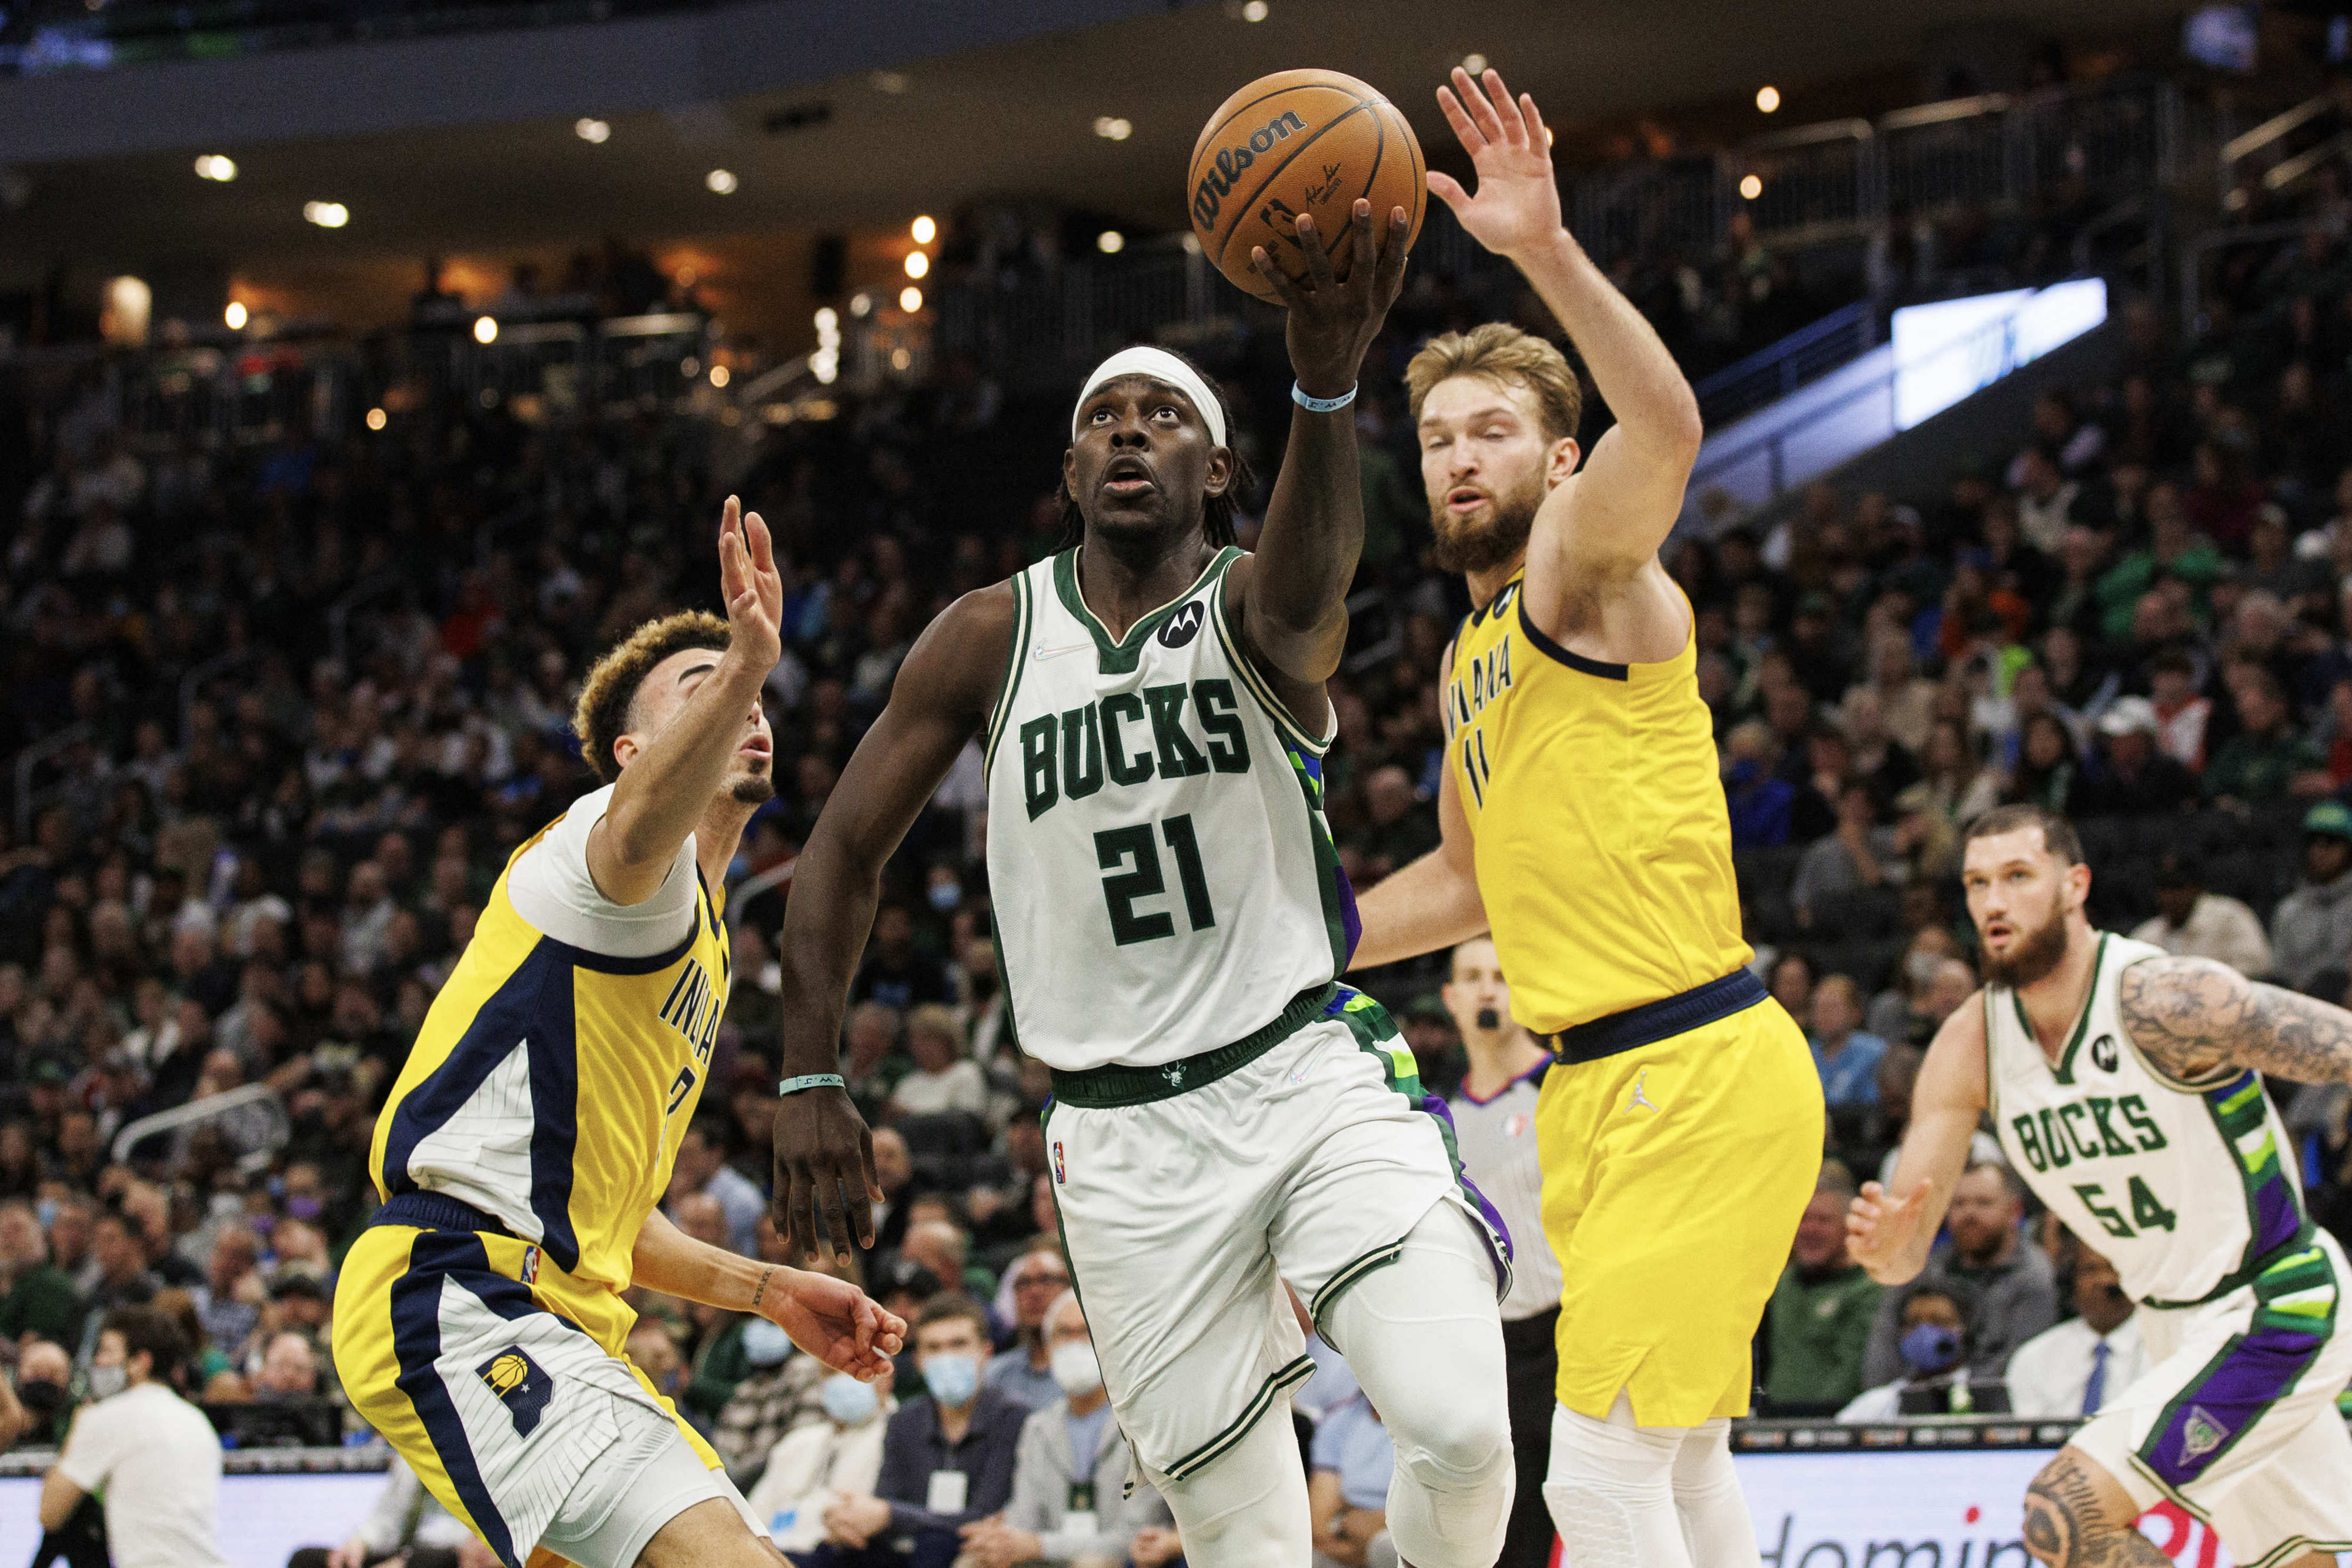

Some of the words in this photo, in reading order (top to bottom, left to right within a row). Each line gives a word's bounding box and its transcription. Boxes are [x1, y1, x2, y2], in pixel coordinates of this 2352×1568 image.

[1193, 110, 1307, 233] Wilson
[1020, 678, 1251, 823] BUCKS
[1464, 726, 1490, 812] 11
[1093, 813, 1216, 947] 21
[2012, 1094, 2169, 1174] BUCKS
[2069, 1174, 2177, 1239] 54
